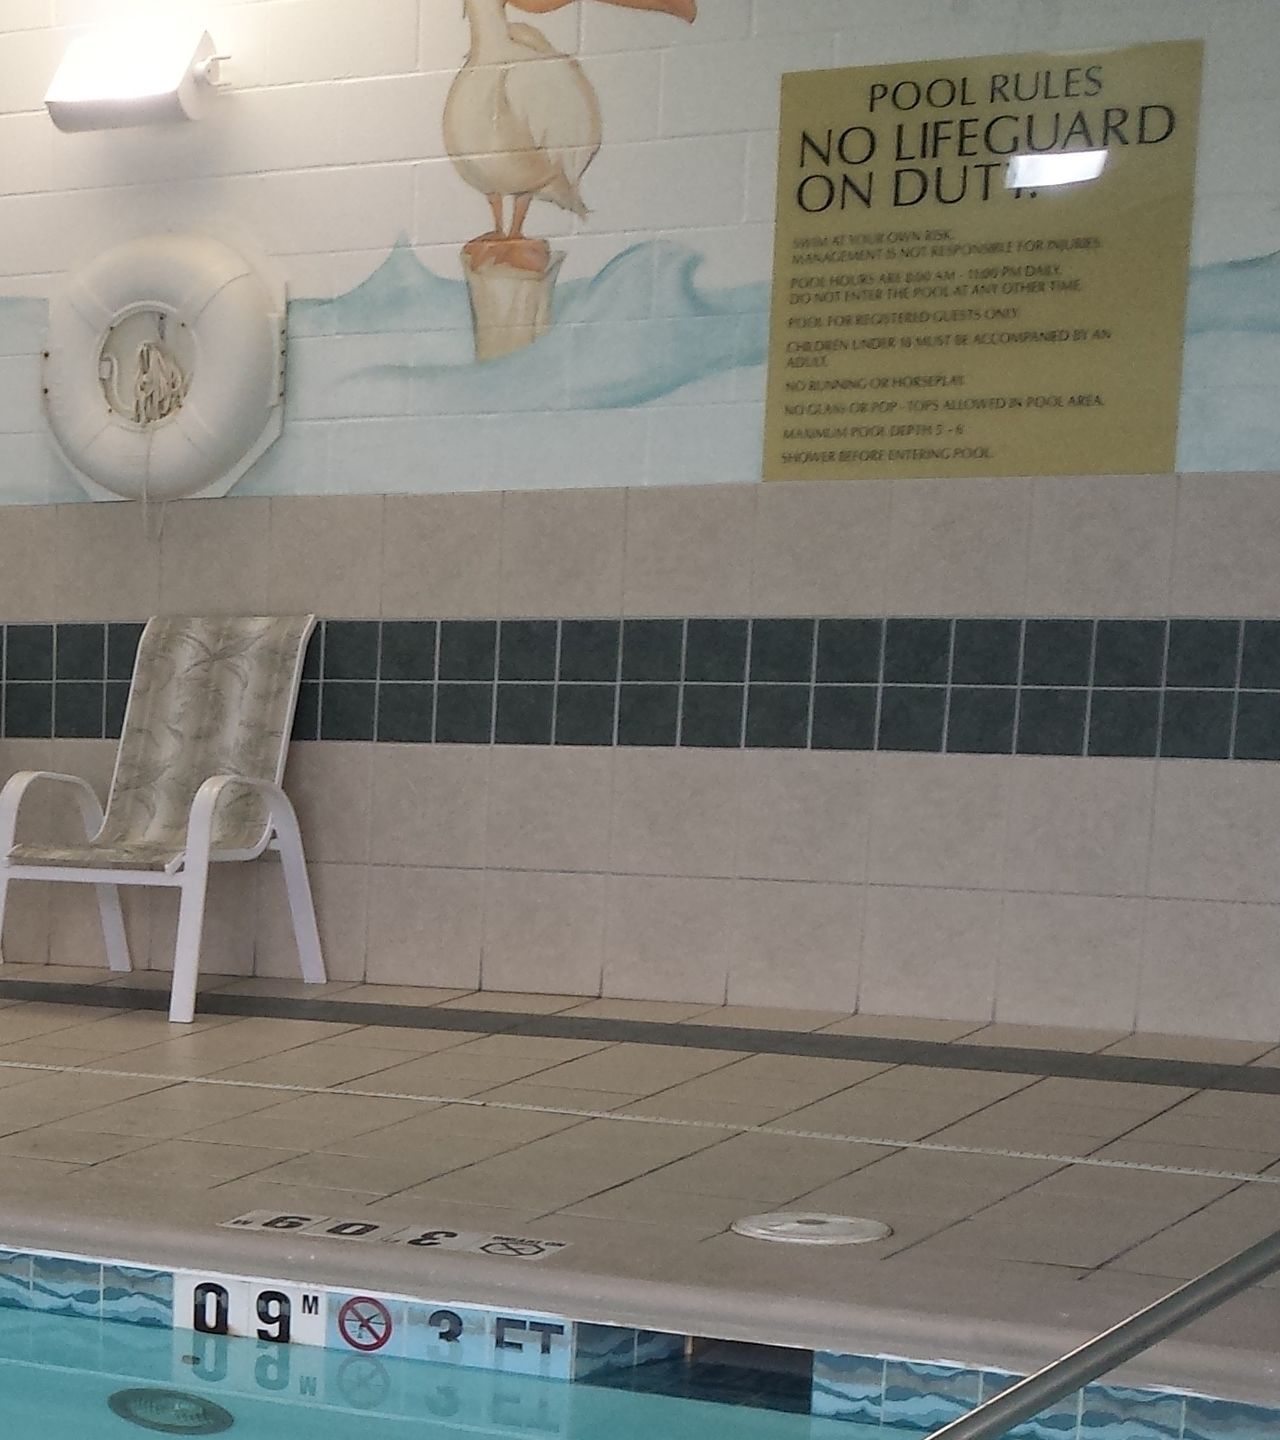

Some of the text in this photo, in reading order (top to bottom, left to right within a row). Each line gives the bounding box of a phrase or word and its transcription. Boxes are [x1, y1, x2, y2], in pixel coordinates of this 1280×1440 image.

[868, 65, 1105, 113] POOL RULES
[798, 103, 1176, 168] NO LIFEGUARD
[796, 171, 872, 213] ON
[832, 235, 848, 246] AT
[850, 233, 883, 245] YOUR
[887, 231, 921, 242] OWN
[792, 249, 882, 264] MANAGEMENT
[901, 246, 927, 258] NOT
[931, 242, 1012, 257] RESPONSIBLE
[1018, 239, 1044, 251] FOR
[791, 277, 825, 289] POOL
[830, 274, 874, 287] HOURS
[879, 272, 901, 284] ARE
[936, 271, 955, 281] AM
[1001, 266, 1021, 278] PM
[789, 293, 810, 305] DO
[814, 291, 841, 303] NOT
[845, 289, 882, 302] ENTER
[887, 288, 909, 300] THE
[913, 286, 948, 298] POOL
[953, 285, 968, 296] AT
[972, 284, 997, 295] ANY
[1002, 281, 1045, 294] OTHER
[788, 315, 822, 328] POOL
[828, 314, 852, 326] FOR
[856, 311, 930, 325] REGISTERED
[933, 309, 980, 322] GUESTS
[786, 339, 848, 353] CHILDREN
[853, 337, 895, 351] UNDER
[916, 334, 951, 347] MUST
[955, 334, 968, 345] BE
[973, 329, 1069, 345] ACCOMPANIED
[1073, 329, 1088, 341] BY
[1092, 328, 1111, 340] AN
[785, 380, 805, 392] NO
[808, 378, 867, 392] RUNNING
[870, 377, 888, 389] OR
[784, 404, 803, 415] NO
[807, 402, 844, 415] GLASS
[848, 402, 866, 413] OR
[870, 400, 897, 413] POP
[908, 400, 939, 412] TOPS
[943, 397, 1005, 411] ALLOWED
[1008, 397, 1022, 408] IN
[1026, 395, 1064, 408] POOL
[783, 426, 848, 439] MAXIMUM
[850, 425, 886, 438] POOL
[889, 424, 932, 437] DEPTH
[782, 450, 836, 464] SHOWER
[838, 449, 883, 462] BEFORE
[887, 447, 951, 461] ENTERING
[302, 1295, 319, 1315] M
